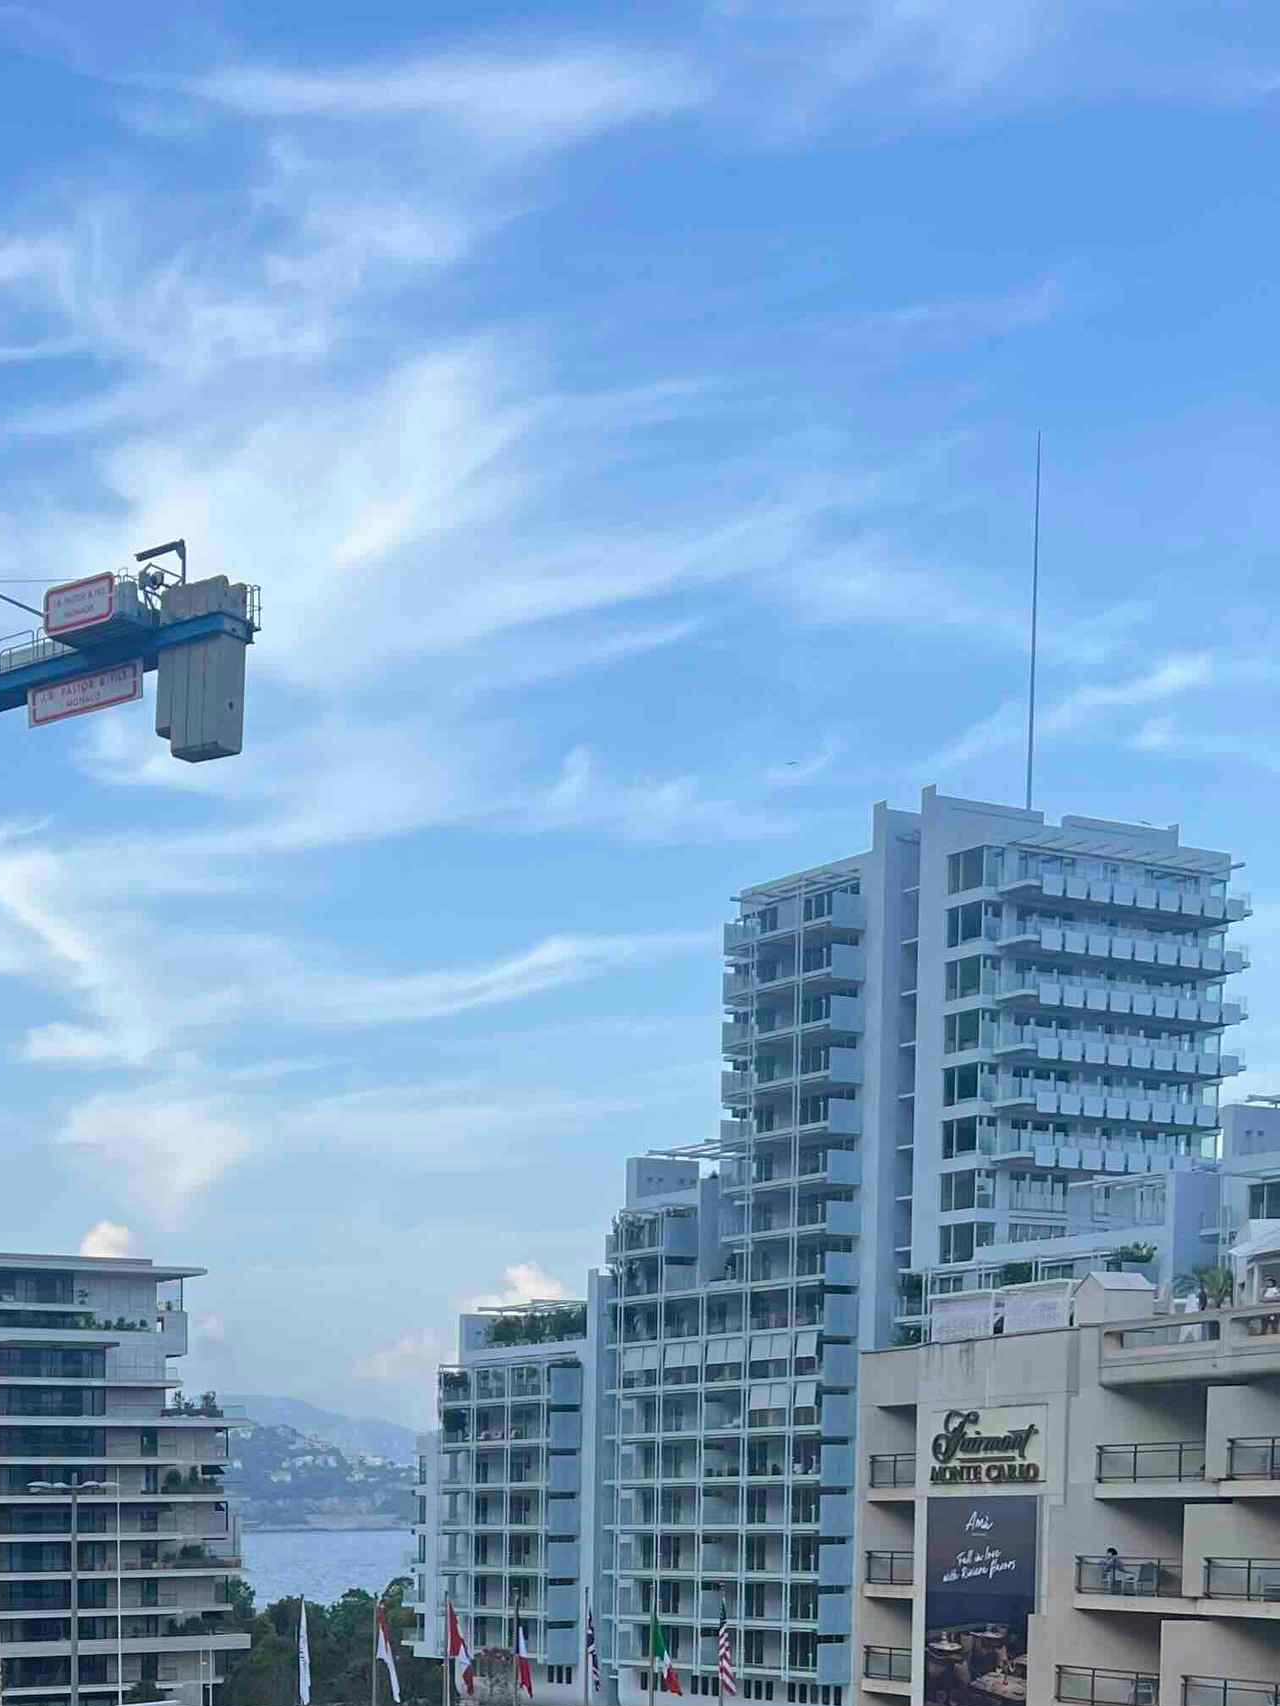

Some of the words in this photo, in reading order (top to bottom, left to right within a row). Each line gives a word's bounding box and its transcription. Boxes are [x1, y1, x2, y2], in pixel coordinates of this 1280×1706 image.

[931, 1410, 1040, 1464] Fairmont
[930, 1465, 982, 1482] MONTE
[985, 1463, 1040, 1482] CARLO
